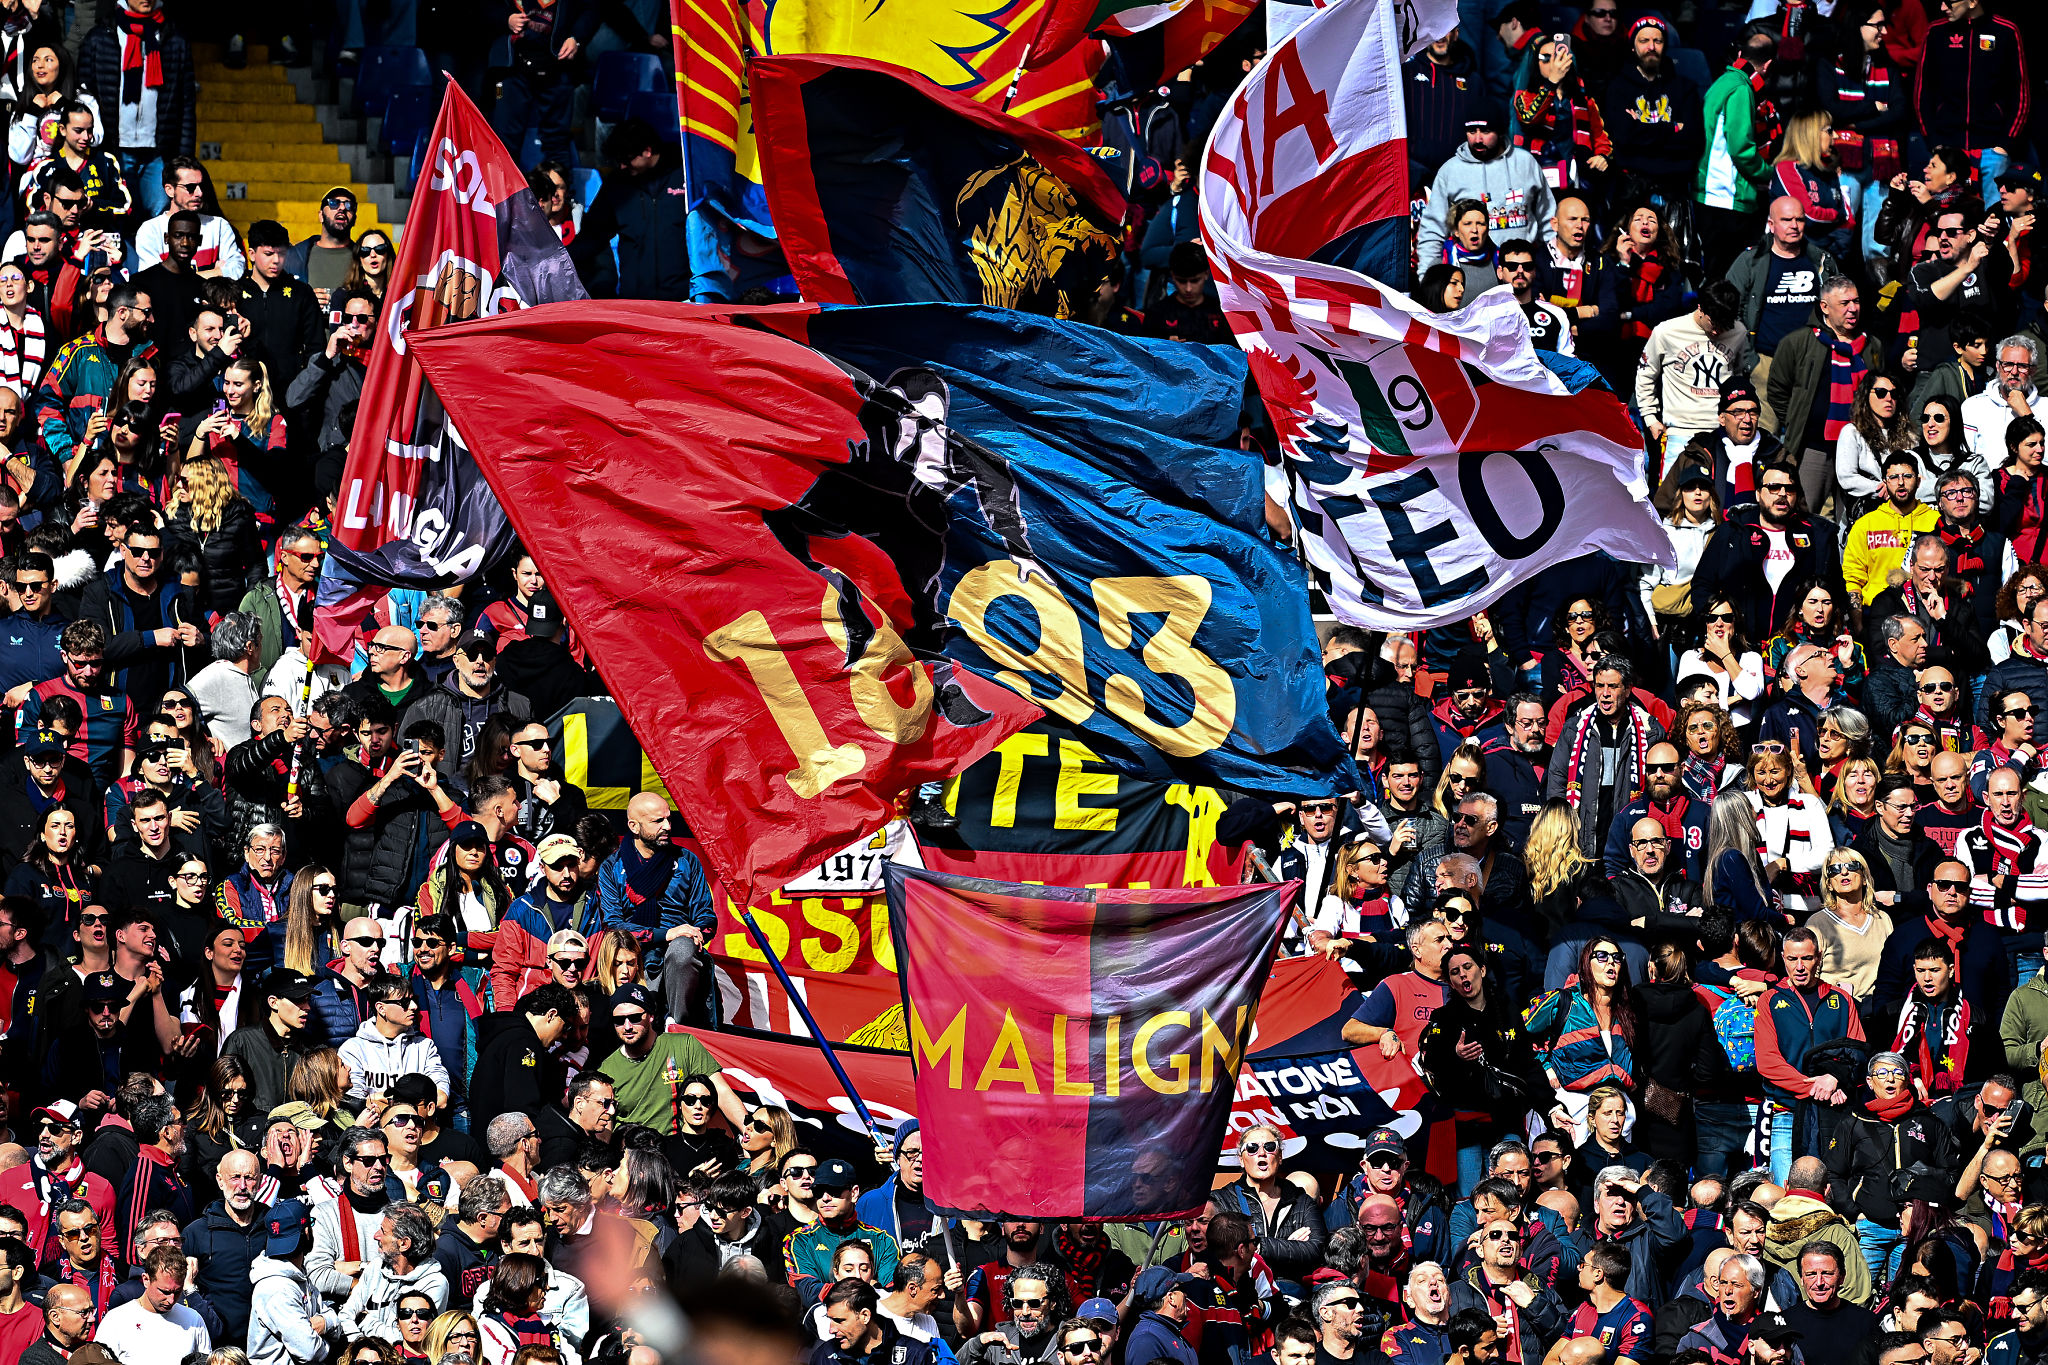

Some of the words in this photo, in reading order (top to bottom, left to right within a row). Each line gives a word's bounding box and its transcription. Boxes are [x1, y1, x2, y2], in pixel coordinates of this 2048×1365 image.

[910, 994, 1258, 1099] MALIGN
[1231, 1056, 1362, 1103] ATONE
[1225, 1106, 1292, 1137] ON
